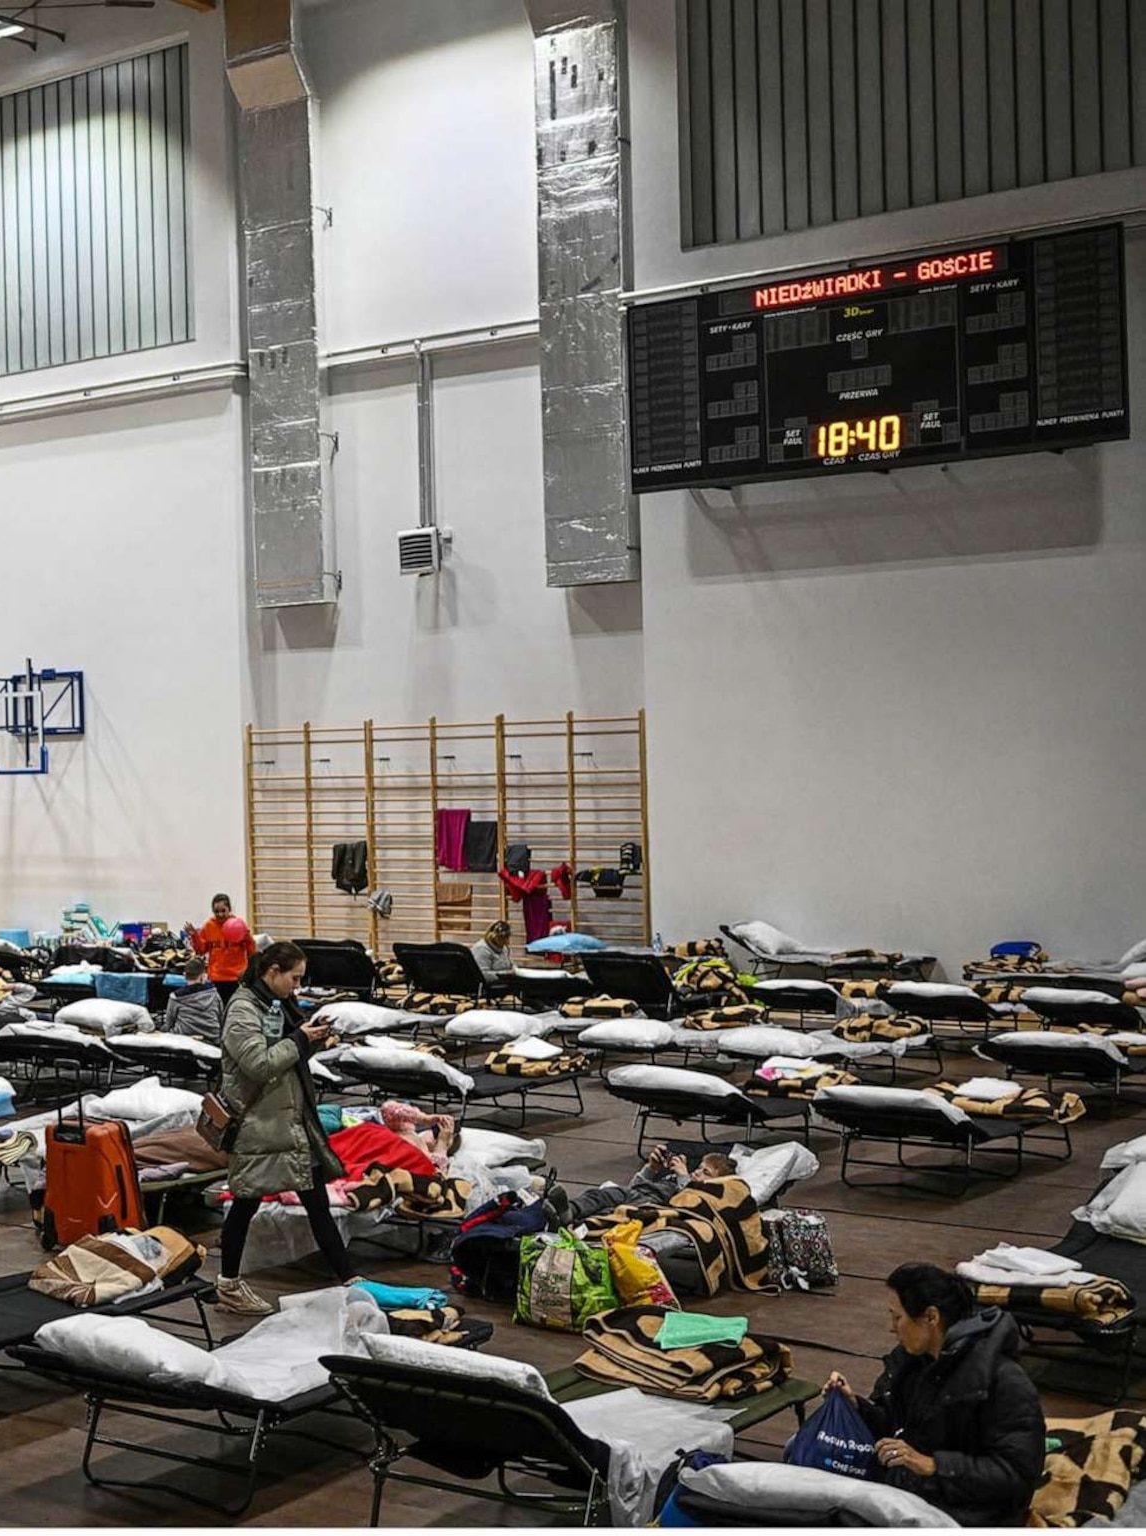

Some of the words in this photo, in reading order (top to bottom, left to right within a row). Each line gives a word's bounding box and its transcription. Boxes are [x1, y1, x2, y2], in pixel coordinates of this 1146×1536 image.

[865, 328, 884, 338] GRY
[839, 388, 879, 400] PRZERWA
[922, 412, 940, 421] SET
[920, 420, 942, 429] FAUL
[785, 429, 802, 438] SET
[818, 415, 900, 457] 18:40
[782, 436, 803, 446] FAUL
[823, 458, 846, 466] CZAS
[858, 452, 882, 462] CZAS
[882, 450, 901, 459] GRY
